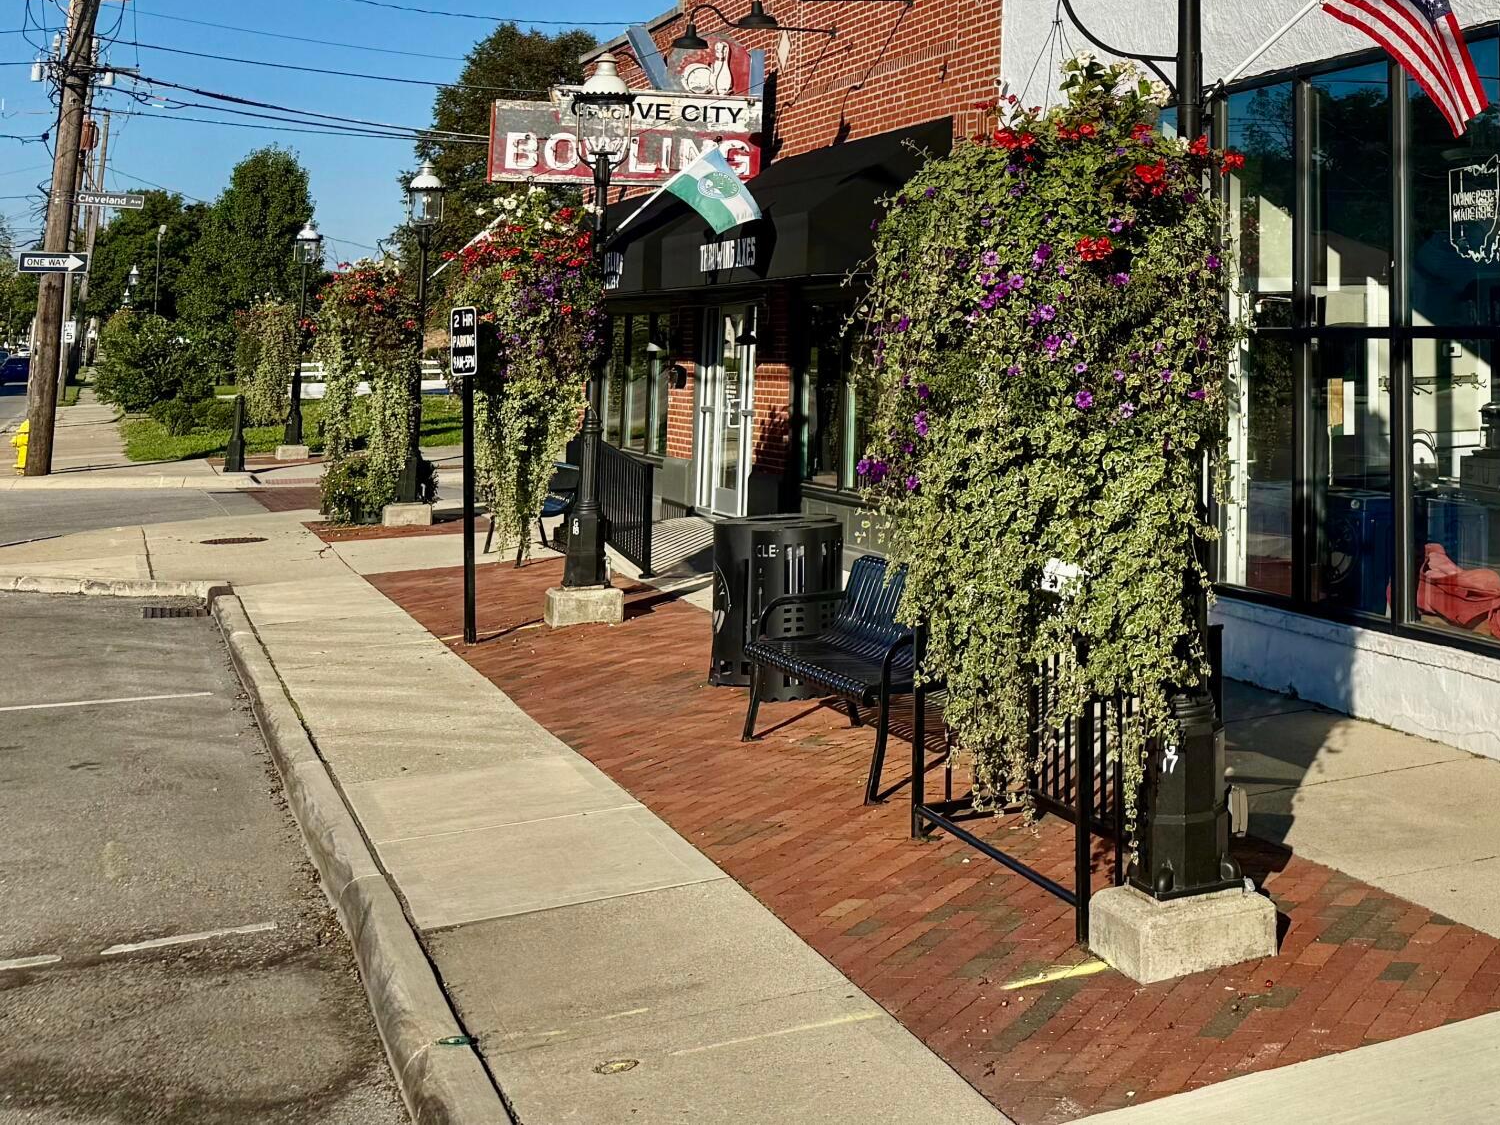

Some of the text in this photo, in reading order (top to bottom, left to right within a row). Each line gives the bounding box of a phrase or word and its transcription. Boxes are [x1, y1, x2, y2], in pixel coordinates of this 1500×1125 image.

[681, 103, 743, 124] CITY
[505, 132, 750, 175] BOWLING
[78, 194, 127, 206] Cleveland
[26, 258, 67, 267] ONE WAY
[700, 236, 756, 273] THROWING AXES
[453, 313, 474, 328] 2 HR
[452, 334, 475, 349] PARKING
[1162, 755, 1179, 774] 17
